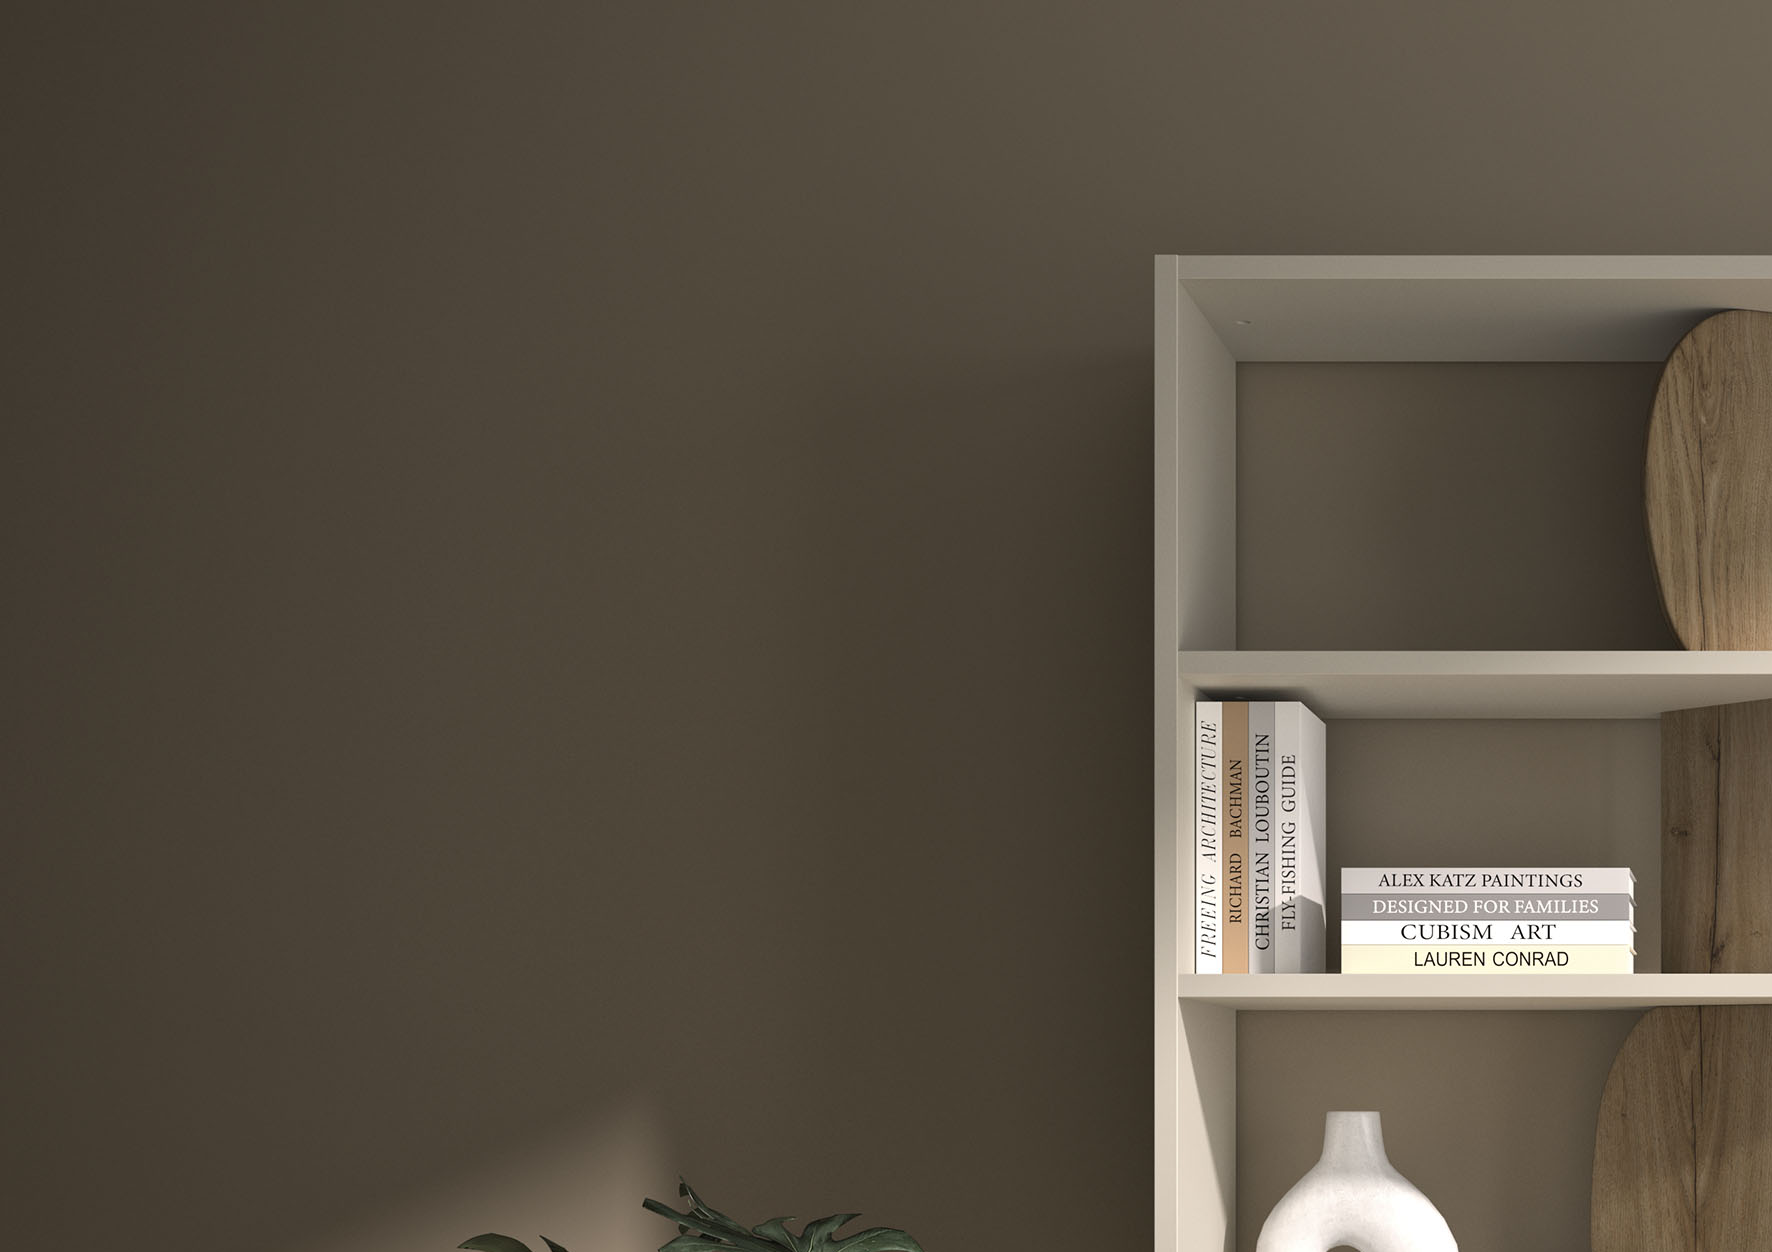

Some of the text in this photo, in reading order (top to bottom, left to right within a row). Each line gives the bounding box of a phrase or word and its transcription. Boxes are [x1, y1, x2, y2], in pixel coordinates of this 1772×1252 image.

[1200, 720, 1216, 958] FREEING ARCHITECTURE
[1229, 760, 1242, 923] RICHARD BACHMAN
[1255, 734, 1270, 950] CHRISTIAN LOUBOUTIN
[1281, 755, 1296, 930] FLY-FISHING GUIDE
[1378, 873, 1583, 888] ALEX KATZ PAINTINGS
[1372, 900, 1599, 914] DESIGNED FOR FAMILIES
[1400, 924, 1556, 940] CUBISM ART
[1414, 951, 1569, 967] LAUREN CONRAD
